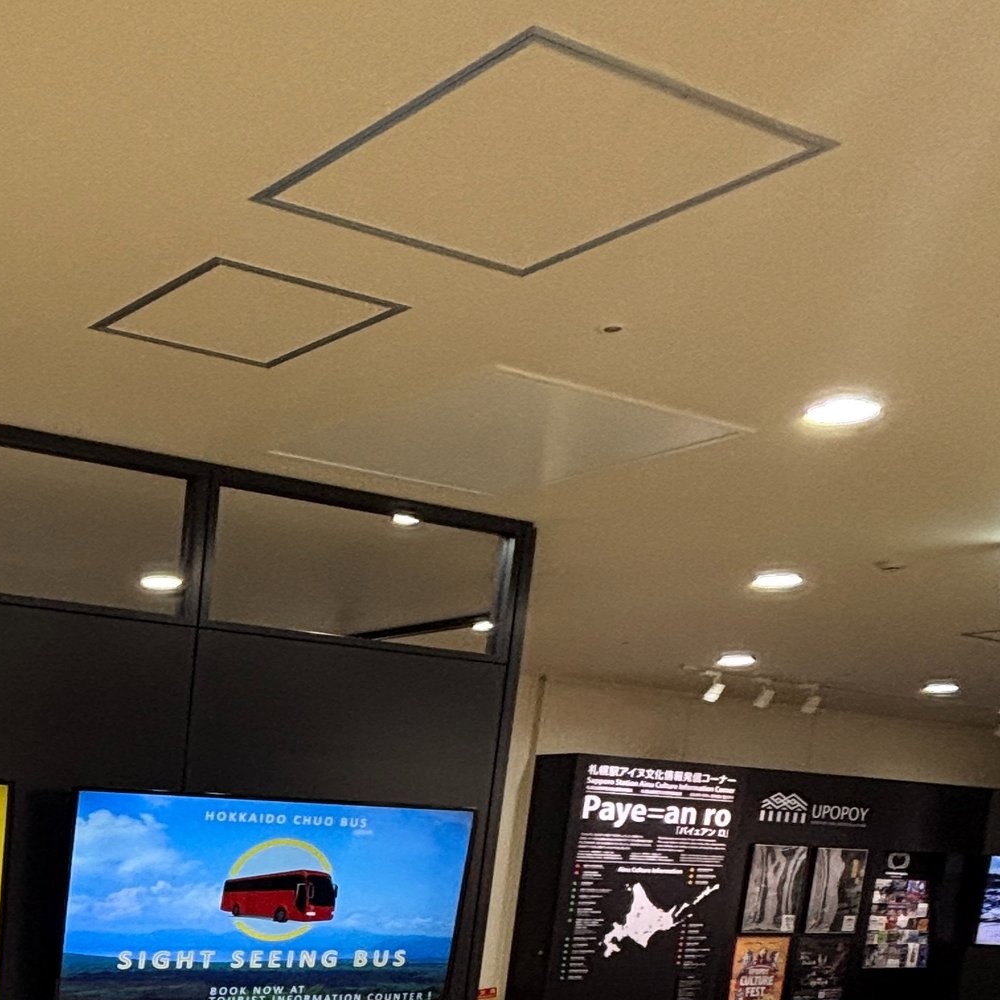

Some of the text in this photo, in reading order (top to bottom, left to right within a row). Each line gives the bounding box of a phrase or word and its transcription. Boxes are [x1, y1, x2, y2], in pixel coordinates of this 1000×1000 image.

[655, 782, 678, 790] Culture
[715, 785, 736, 794] Corner
[204, 811, 368, 829] HOKKAIDO CHUO BUS
[703, 808, 732, 828] ro
[811, 804, 870, 822] UPOPOY
[116, 949, 408, 971] SIGHT SEEING BUS
[740, 975, 774, 987] CULTURE
[209, 985, 305, 996] BOOK NOW AT
[745, 986, 767, 998] FEST
